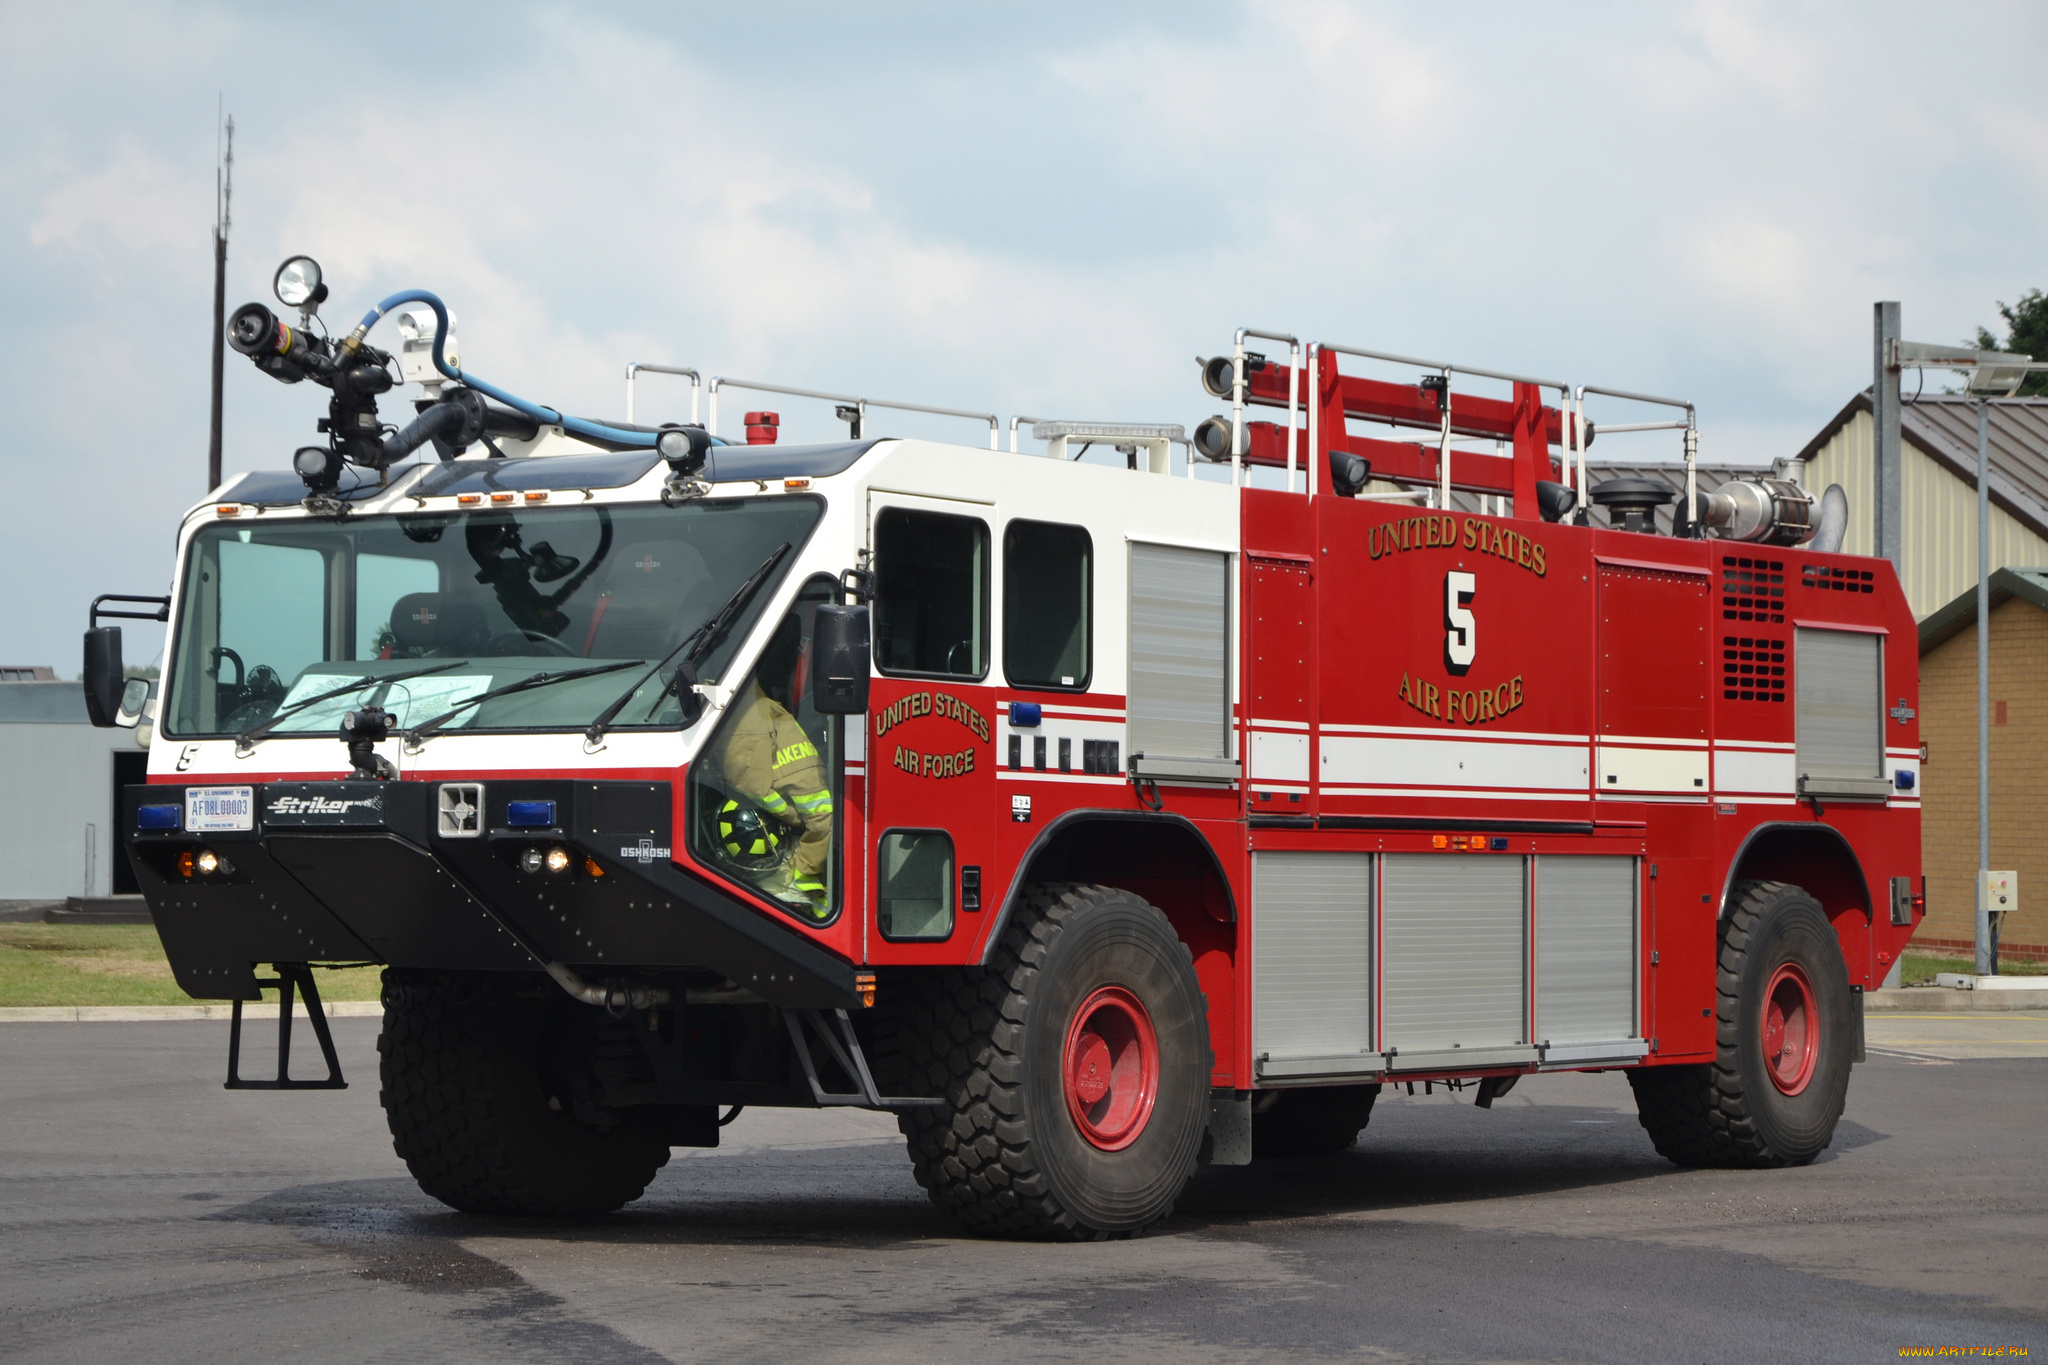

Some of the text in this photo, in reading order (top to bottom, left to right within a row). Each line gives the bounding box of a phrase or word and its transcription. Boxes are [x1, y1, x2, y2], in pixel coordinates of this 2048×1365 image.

[1368, 515, 1546, 578] UNITED STATES
[1443, 570, 1475, 677] 5
[876, 691, 990, 744] UNITED STATES
[1398, 669, 1524, 726] AIR FORCE
[175, 743, 201, 772] 5
[893, 745, 975, 779] AIR FORCE
[267, 796, 354, 814] Striker
[620, 847, 671, 858] OSHKOSH
